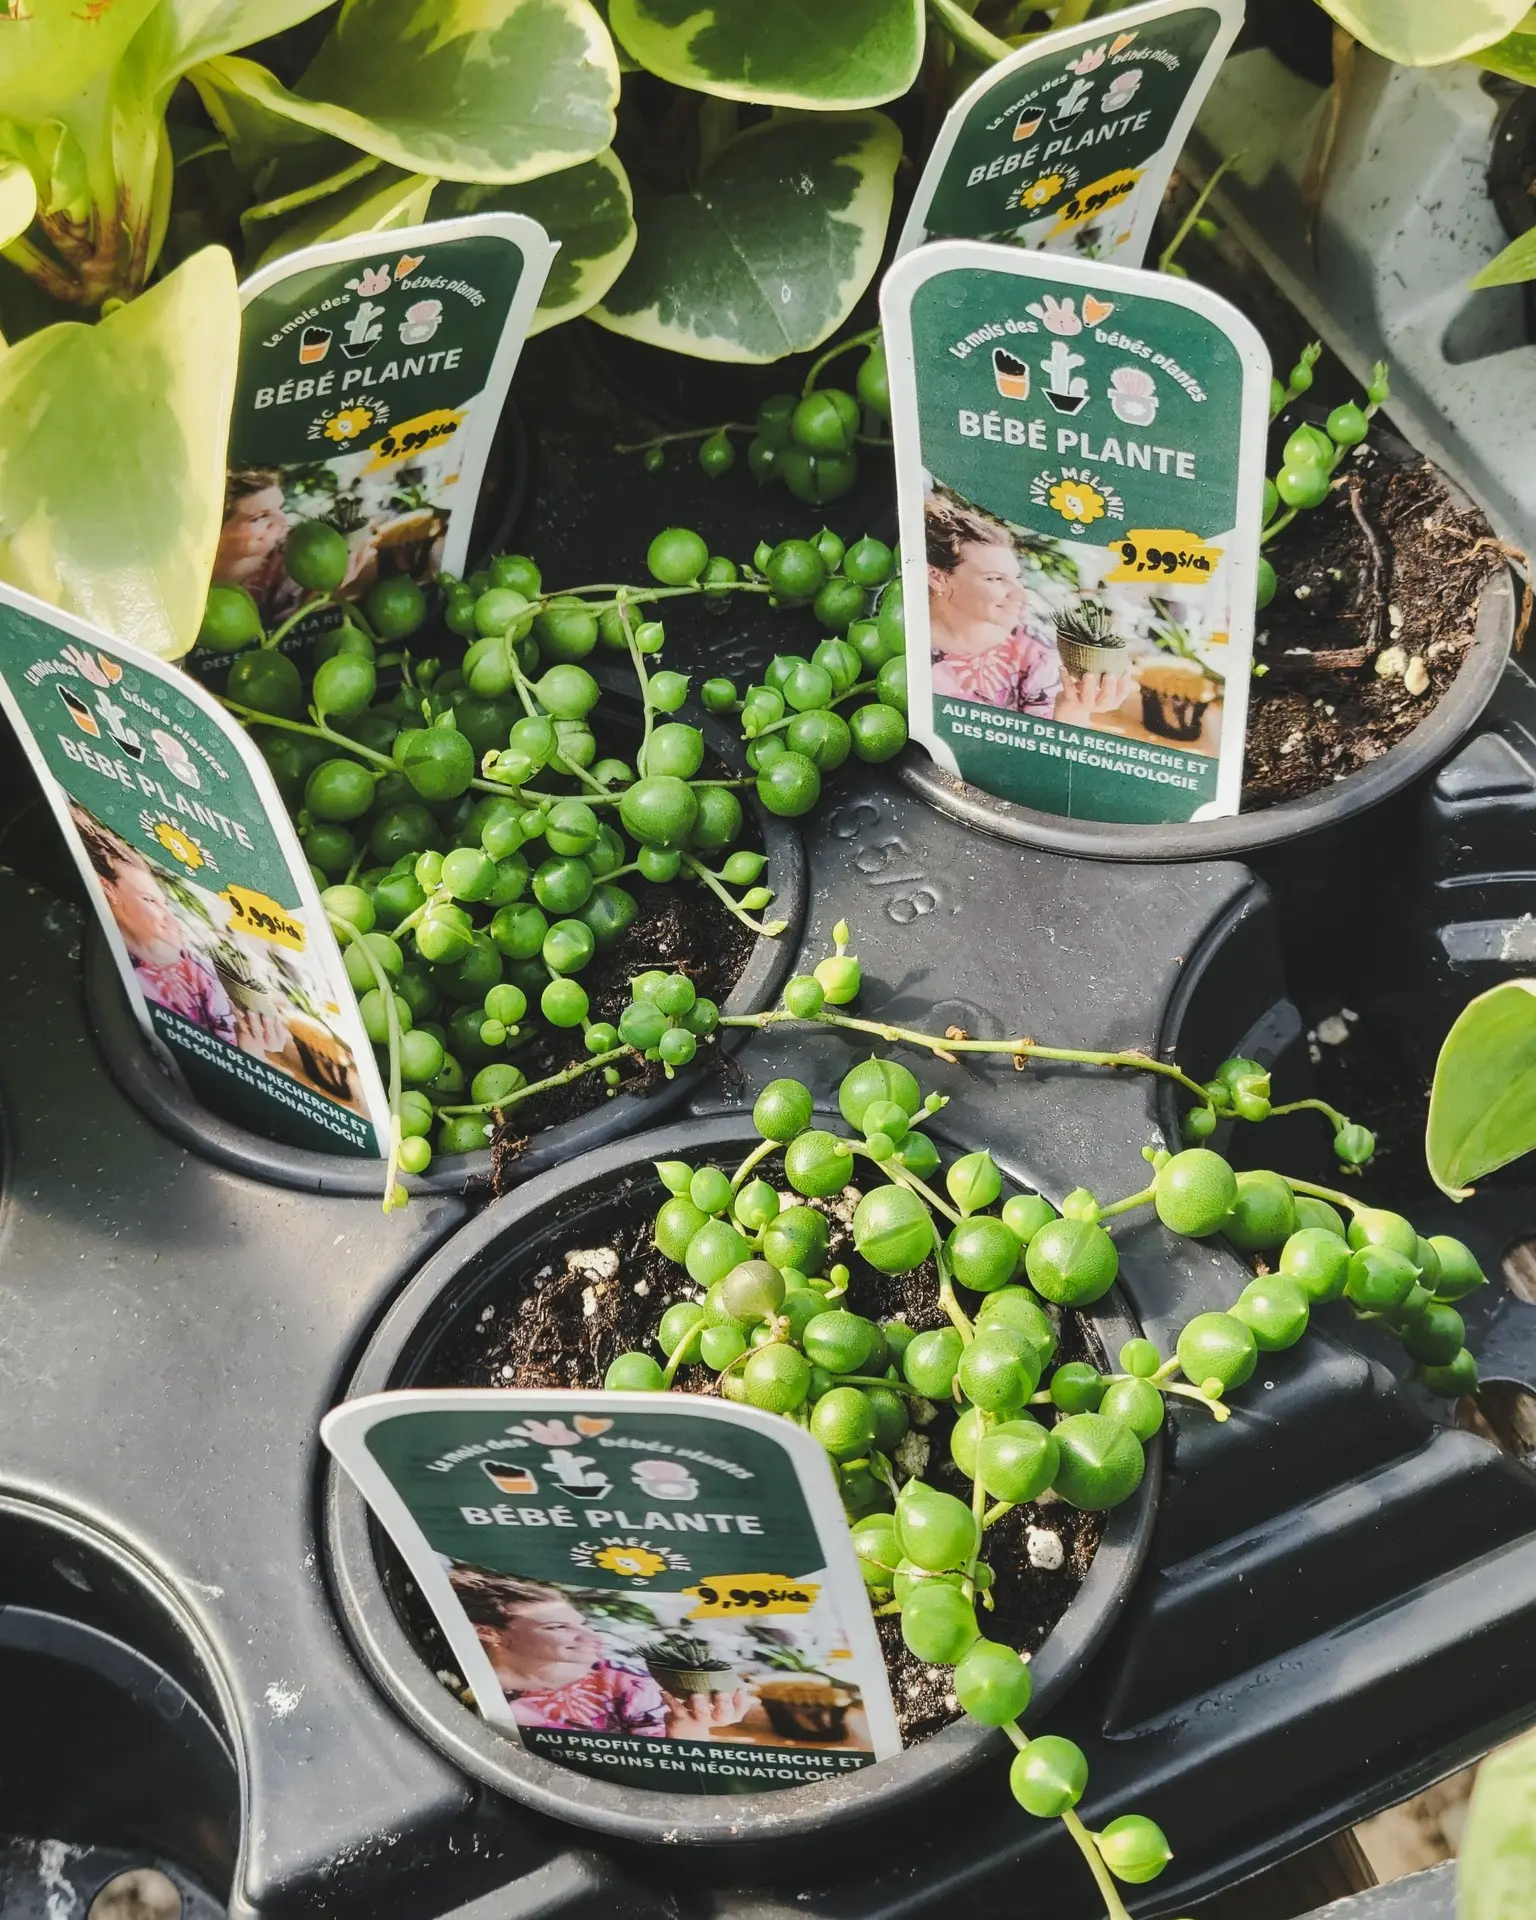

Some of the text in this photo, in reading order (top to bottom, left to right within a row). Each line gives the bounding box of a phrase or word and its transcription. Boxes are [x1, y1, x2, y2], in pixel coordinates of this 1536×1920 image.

[986, 117, 1004, 130] Le
[1003, 89, 1039, 116] mois
[1041, 74, 1068, 92] des
[966, 110, 1152, 187] BÉBÉ PLANTE
[1005, 179, 1033, 210] AVEC
[262, 275, 487, 348] Le mois des bébés plantes
[253, 348, 464, 409] BÉBÉ PLANTE
[949, 319, 1207, 403] Le mois des bébés plantes
[306, 409, 335, 441] AVEC
[959, 409, 1196, 480] BÉBÉ PLANTE
[1029, 470, 1057, 506] AVEC
[1121, 543, 1210, 574] 9,99$/ch
[119, 686, 170, 725] bébés
[172, 724, 230, 779] plantes
[942, 703, 1209, 776] AU PROFIT DE LA RECHERCHE ET
[951, 721, 1199, 792] DES SOINS EN NÉONATOLOGIE
[57, 733, 255, 850] BÉBÉ PLANTE
[138, 808, 160, 843] AVEC
[154, 1008, 368, 1137] AU PROFIT DE LA RECHERCHE ET
[166, 1028, 366, 1149] DES SOINS EN NÉONATOLOGIE
[459, 1503, 765, 1536] BÉBÉ PLANTE
[570, 1537, 600, 1569] AVEC
[535, 1733, 864, 1769] AU PROFIT DE LA RECHERCHE ET
[552, 1748, 847, 1781] DES SOINS EN NÉONATOLOG
